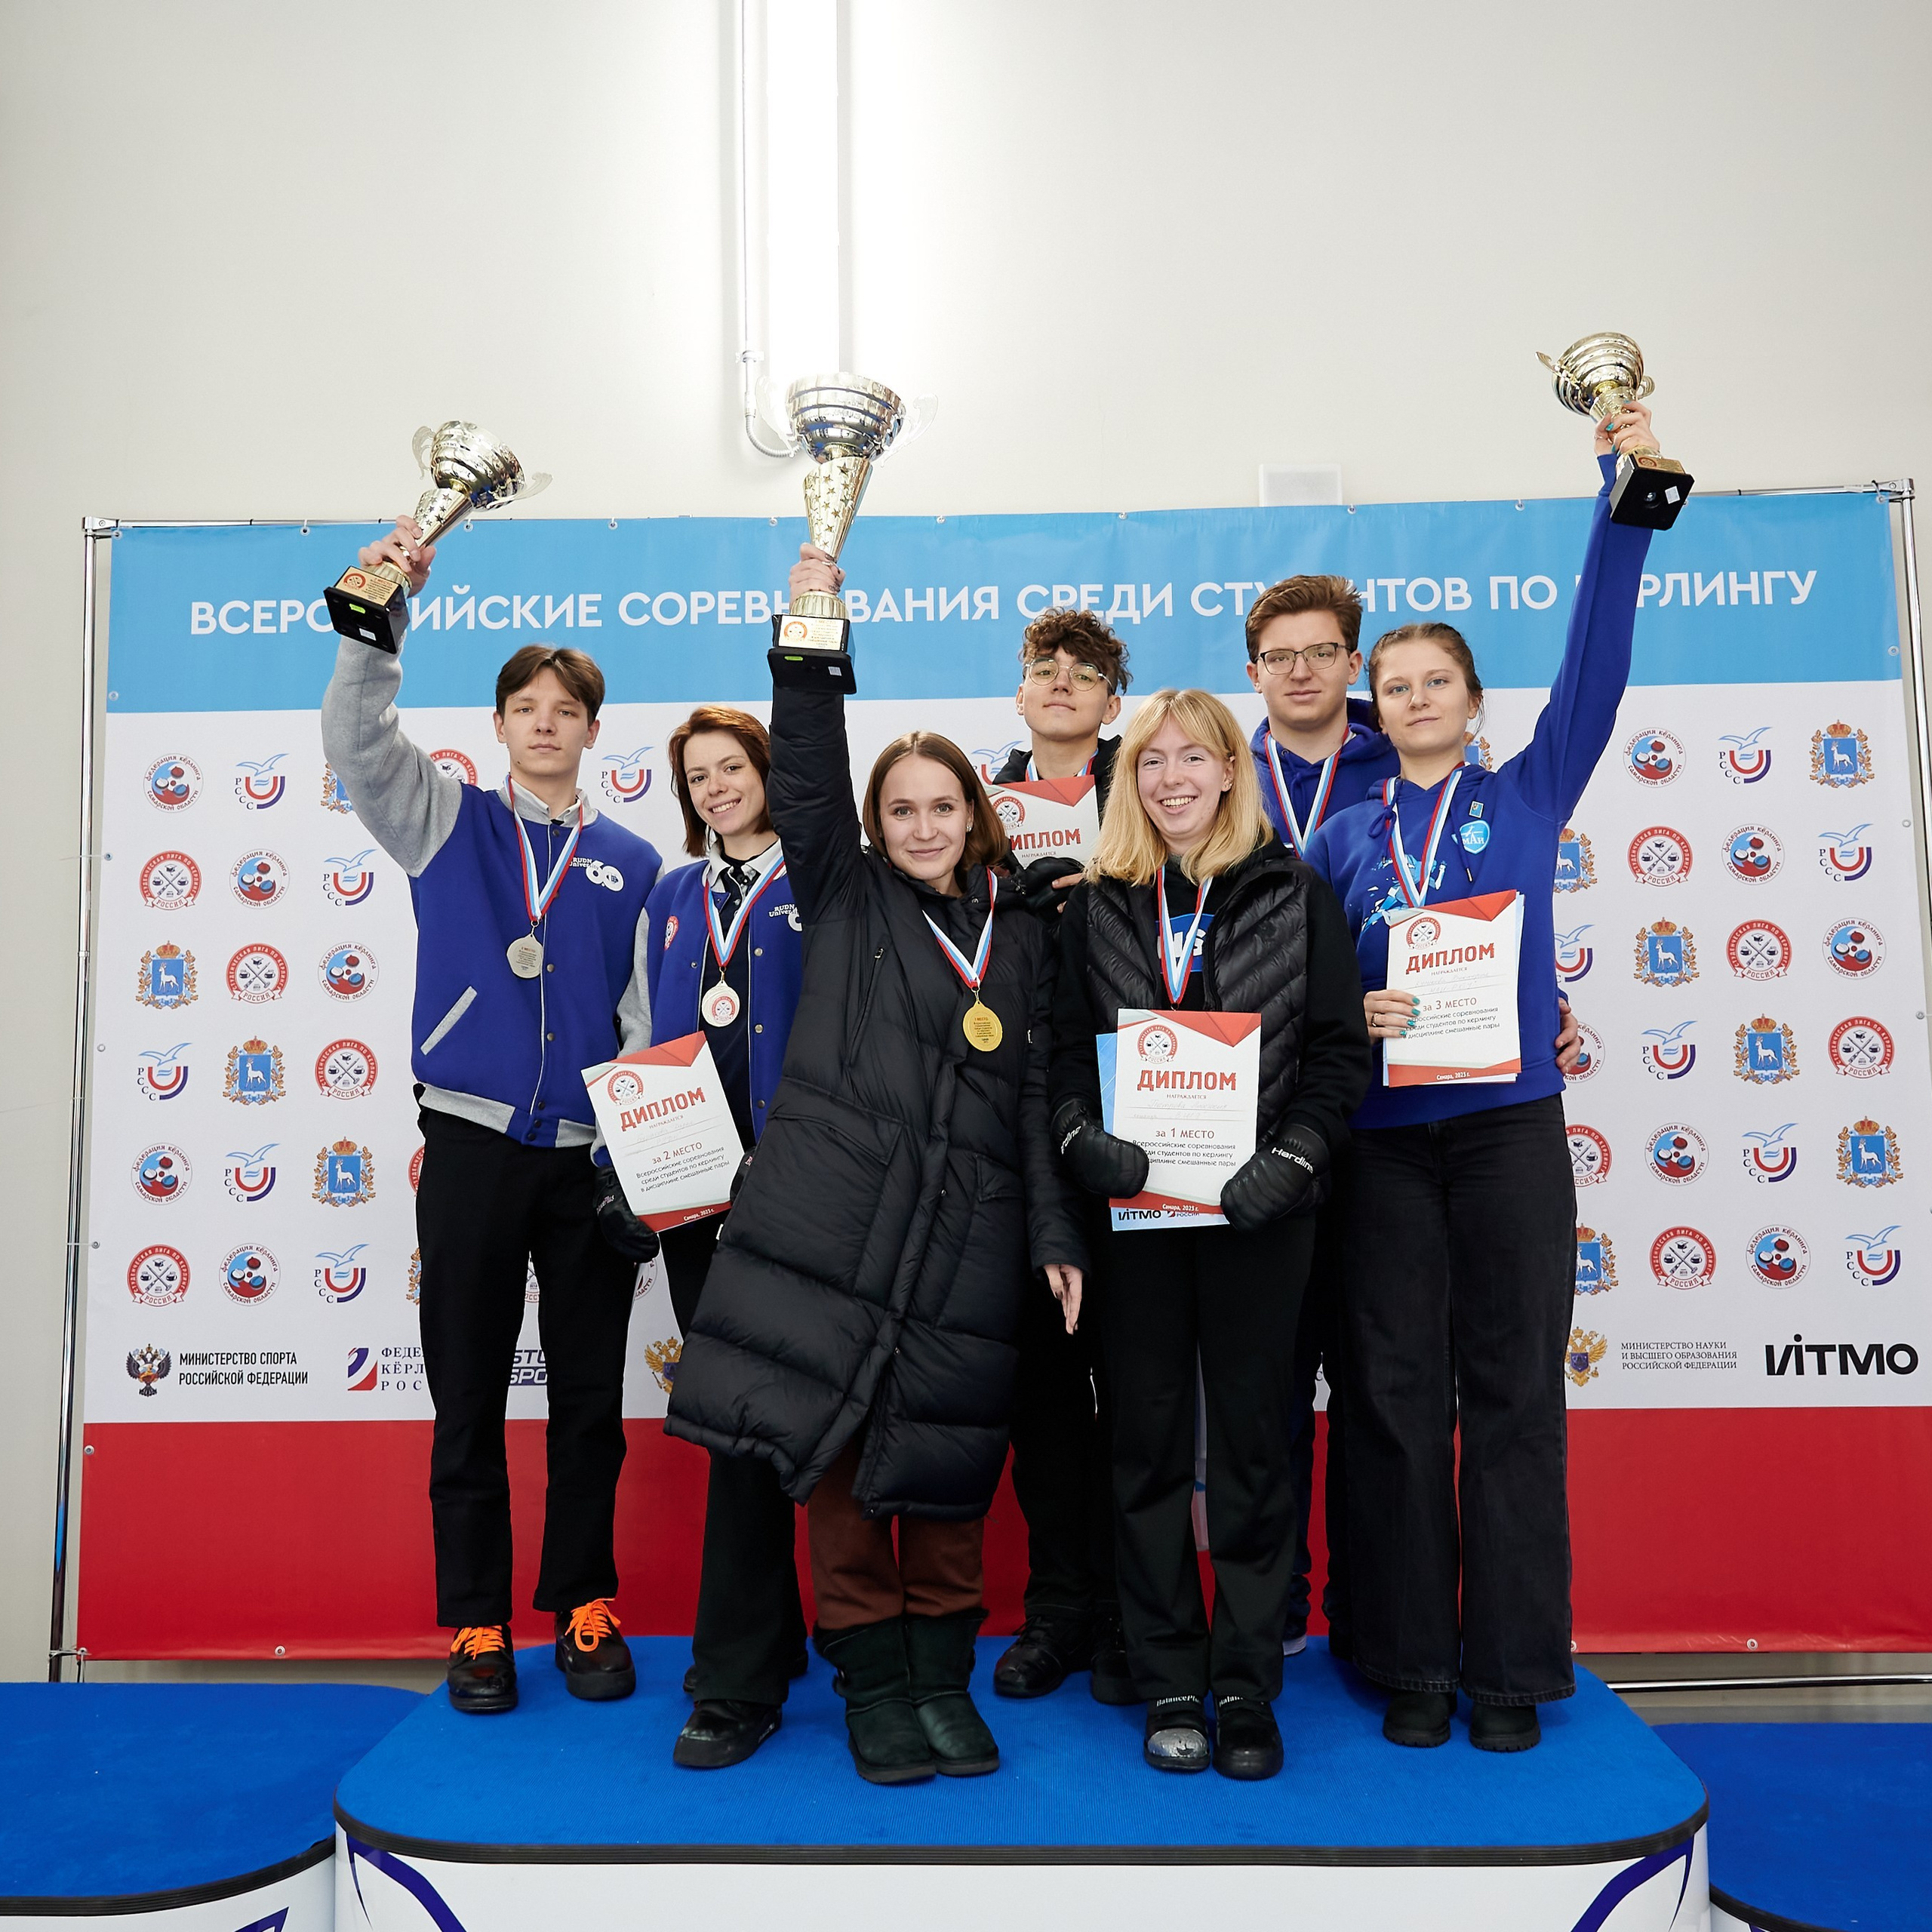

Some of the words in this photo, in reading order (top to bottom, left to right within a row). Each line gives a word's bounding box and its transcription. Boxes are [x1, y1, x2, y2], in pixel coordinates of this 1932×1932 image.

[190, 585, 602, 635] ВСЕРОИЙСКИЕ
[1017, 583, 1174, 625] СРЕДИ
[1191, 577, 1472, 617] СТНТОВ
[1491, 576, 1558, 611] ПО
[1575, 569, 1817, 608] РЛИНГУ
[1011, 829, 1081, 851] ИПЛОМ
[1463, 834, 1485, 844] МАИ
[1647, 875, 1676, 884] РОССИЯ
[156, 899, 183, 908] РОССИЯ
[1405, 943, 1494, 975] ДИПЛОМ
[1431, 967, 1468, 976] НАГРАЖДАЕТСЯ
[1746, 969, 1775, 979] РОССИЯ
[243, 992, 270, 1001] РОССИЯ
[1435, 1000, 1441, 1010] 3
[1444, 997, 1477, 1009] МЕСТО
[1453, 1007, 1498, 1017] соревнования
[1426, 1020, 1457, 1029] студентов
[1467, 1015, 1497, 1025] керлингу
[1407, 1029, 1444, 1039] дисциплине
[1445, 1024, 1481, 1034] смешанные
[1482, 1023, 1500, 1031] пары
[1137, 1069, 1236, 1091] ДИПЛОМ
[332, 1088, 360, 1097] РОССИЯ
[620, 1087, 706, 1132] ДИПЛОМ
[649, 1115, 684, 1129] НАГРАЖДАЕТСЯ
[1171, 1128, 1176, 1137] 1
[1180, 1131, 1215, 1139] МЕСТО
[663, 1150, 671, 1160] 2
[673, 1142, 703, 1158] МЕСТО
[636, 1161, 681, 1179] Всероссийские
[682, 1146, 724, 1164] соревнования
[641, 1177, 659, 1185] среди
[660, 1166, 688, 1179] студентов
[698, 1154, 724, 1166] керлингу
[645, 1177, 678, 1192] дисциплине
[680, 1165, 713, 1180] смешанные
[714, 1160, 730, 1169] пары
[1669, 1278, 1699, 1287] РОССИЯ
[1621, 1342, 1694, 1351] МИНИСТЕРСТВО
[179, 1352, 258, 1366] МИНИСТЕРСТВО
[260, 1352, 297, 1364] СПОРТА
[1675, 1351, 1737, 1359] ОБРАЗОВАНИЯ
[1622, 1361, 1683, 1370] РОССИЙСКОЙ
[1684, 1361, 1737, 1370] ФЕДЕРАЦИИ
[179, 1371, 244, 1386] РОССИЙСКОЙ
[248, 1371, 308, 1386] ФЕДЕРАЦИИ
